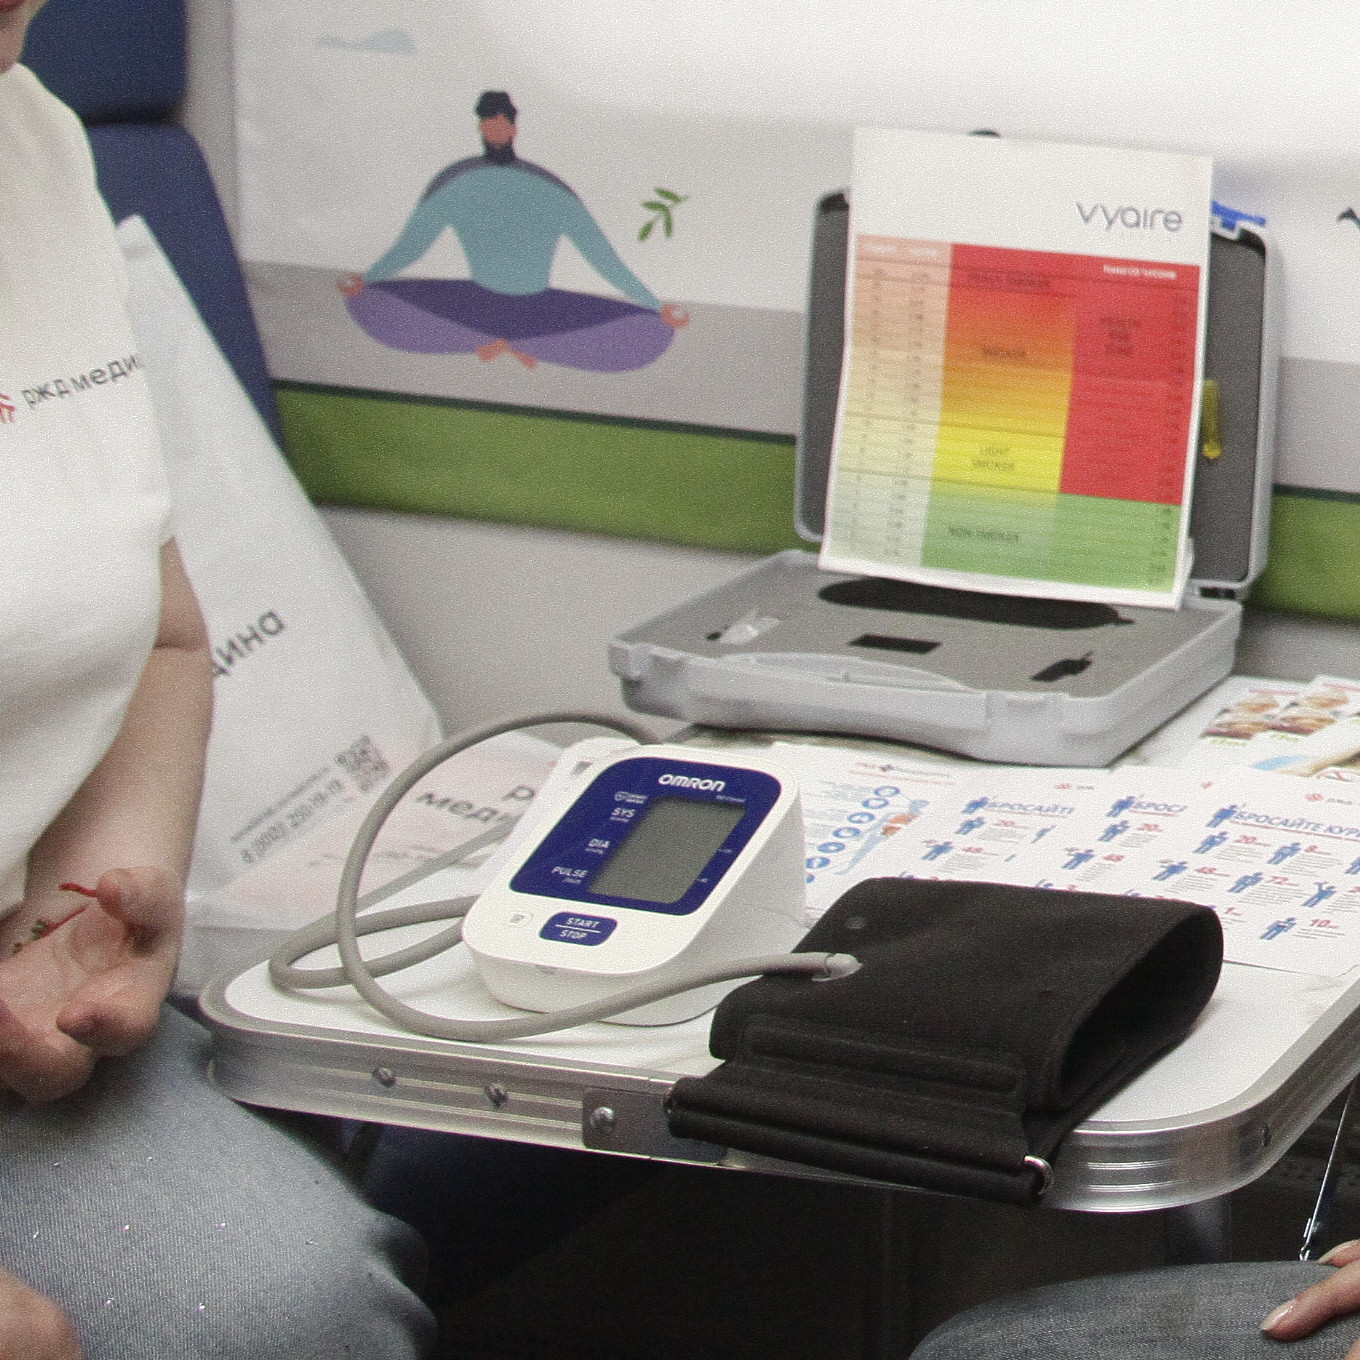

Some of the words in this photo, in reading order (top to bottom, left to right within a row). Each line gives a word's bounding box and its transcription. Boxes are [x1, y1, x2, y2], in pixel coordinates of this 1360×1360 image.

[1076, 201, 1183, 233] vyaire
[658, 773, 725, 792] OMRON
[611, 807, 636, 818] SYS
[1132, 800, 1187, 813] БРОС
[588, 838, 610, 850] DIA
[551, 866, 588, 878] PULSE
[565, 916, 600, 929] START
[559, 929, 588, 940] STOP
